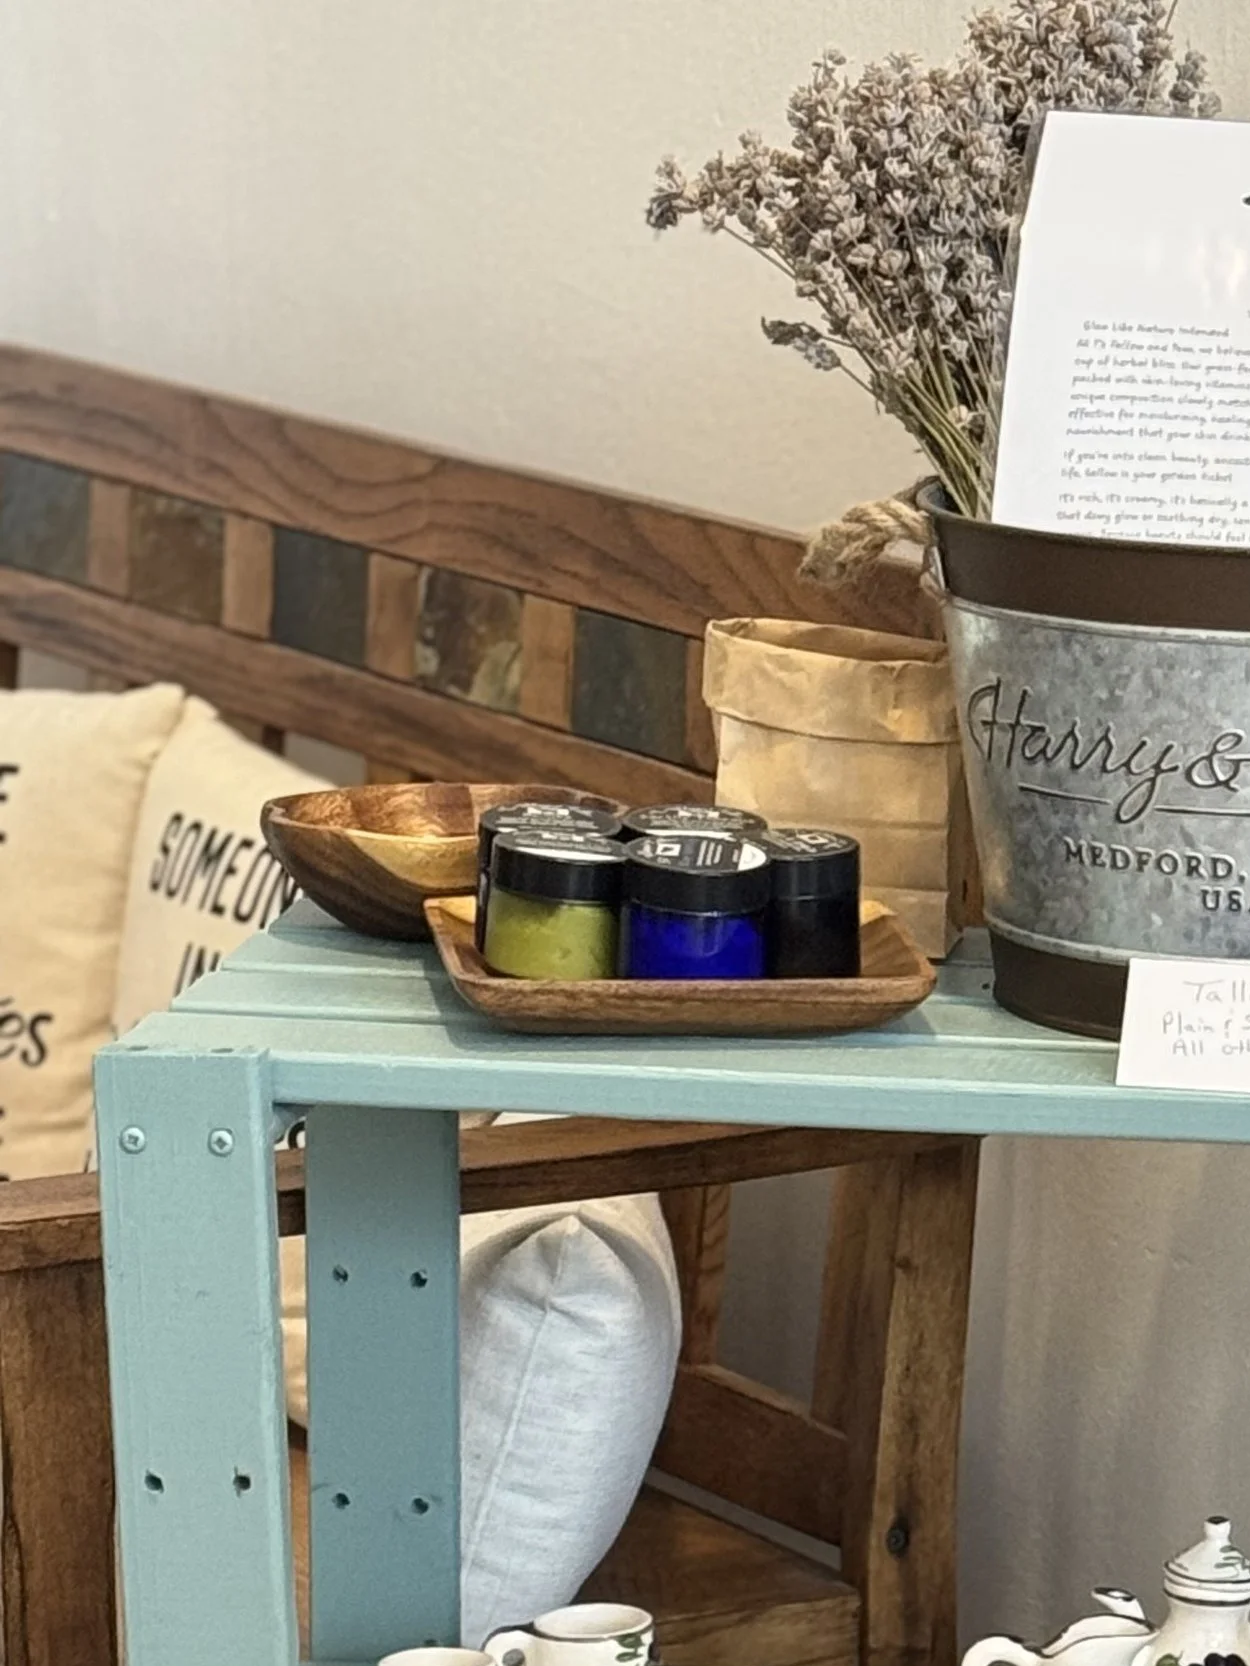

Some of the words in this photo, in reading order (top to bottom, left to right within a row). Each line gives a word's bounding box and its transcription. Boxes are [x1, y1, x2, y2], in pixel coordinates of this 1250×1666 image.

[967, 678, 1182, 824] Harry
[1063, 836, 1248, 884] MEDFORD,
[1162, 1011, 1215, 1035] Plain
[1172, 1038, 1204, 1056] All
